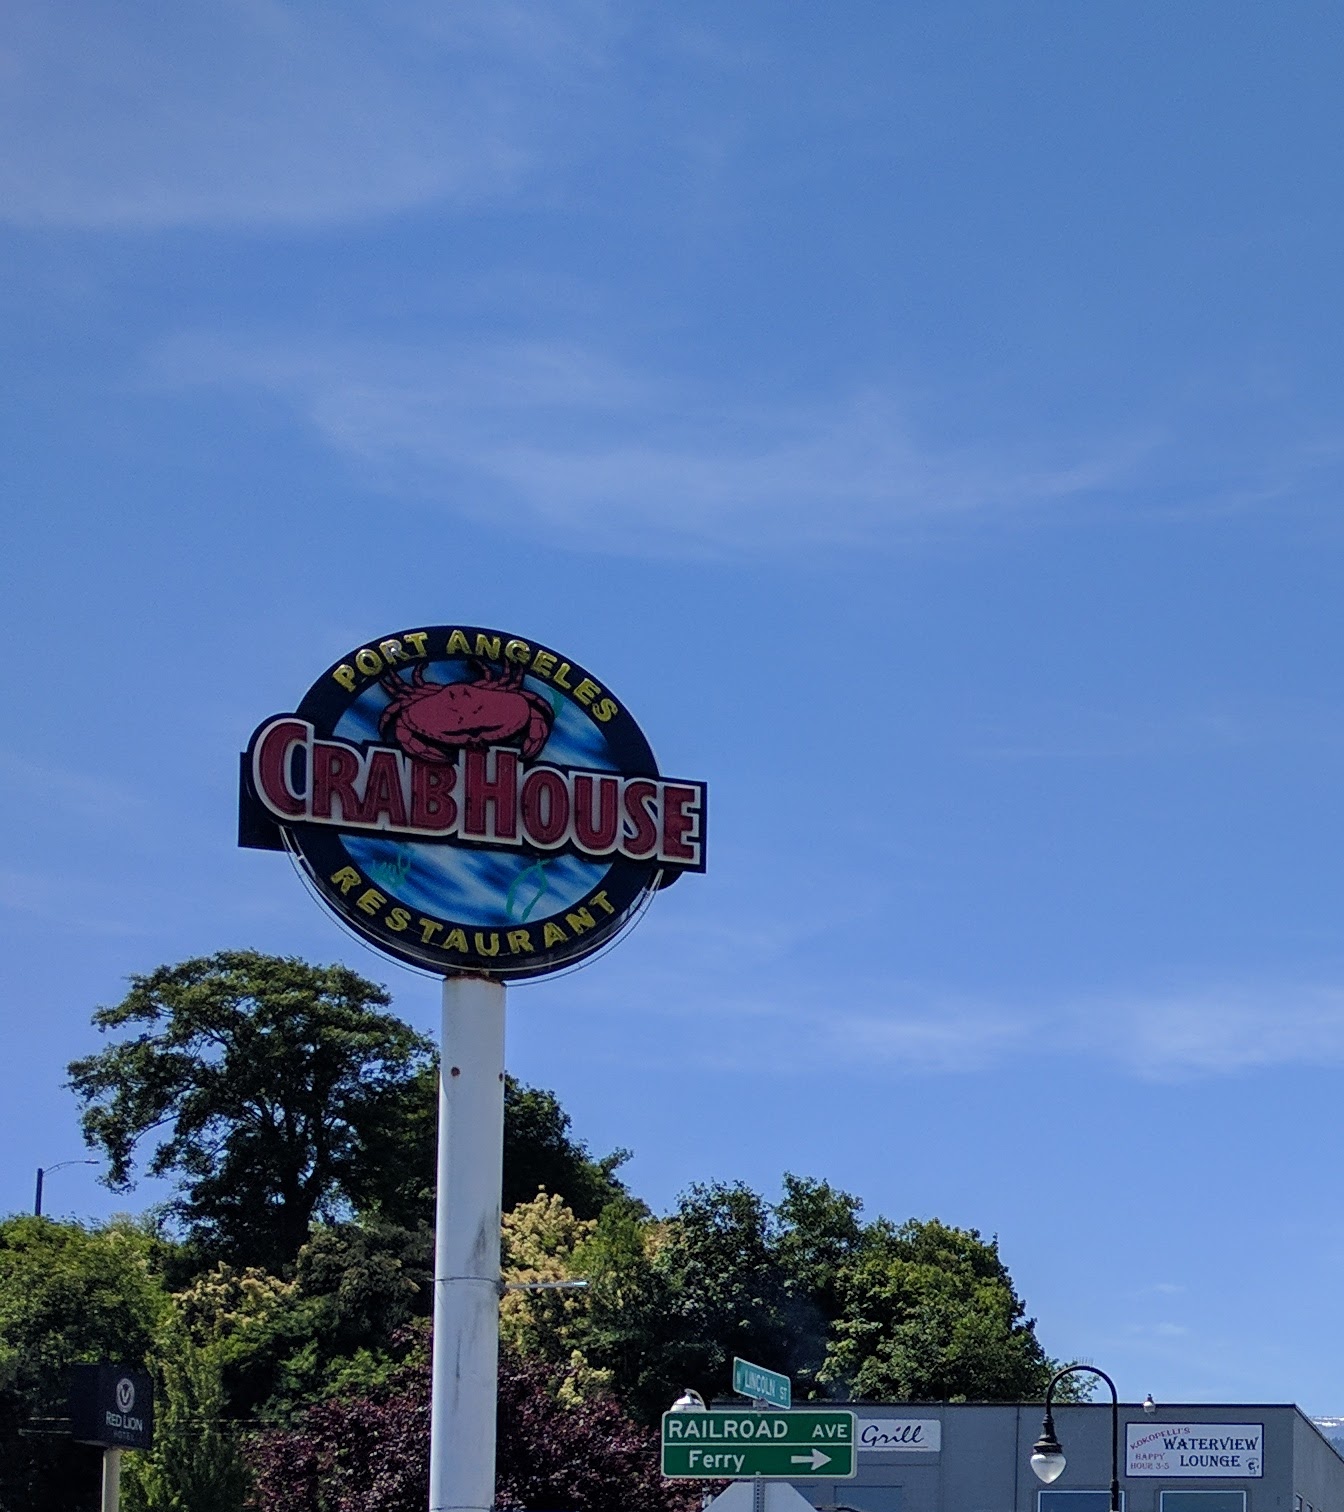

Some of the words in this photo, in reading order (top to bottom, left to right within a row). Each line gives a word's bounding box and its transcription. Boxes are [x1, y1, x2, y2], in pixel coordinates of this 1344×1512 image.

[332, 631, 429, 693] PORT
[446, 630, 619, 723] ANGELES
[331, 865, 616, 957] RESTAURANT
[744, 1371, 776, 1397] LINCOLN
[779, 1387, 789, 1400] ST
[105, 1410, 122, 1428] RED
[123, 1414, 143, 1432] LION
[668, 1420, 788, 1439] RAILROAD
[811, 1423, 848, 1439] AVE
[860, 1424, 924, 1447] Grill
[1129, 1426, 1191, 1451] KOKOPELLI'S
[1163, 1436, 1259, 1451] WATERVIEW
[688, 1449, 746, 1473] Ferry
[1130, 1461, 1153, 1470] HOUR
[1134, 1452, 1166, 1461] HAPPY
[1179, 1454, 1242, 1468] LOUNGE
